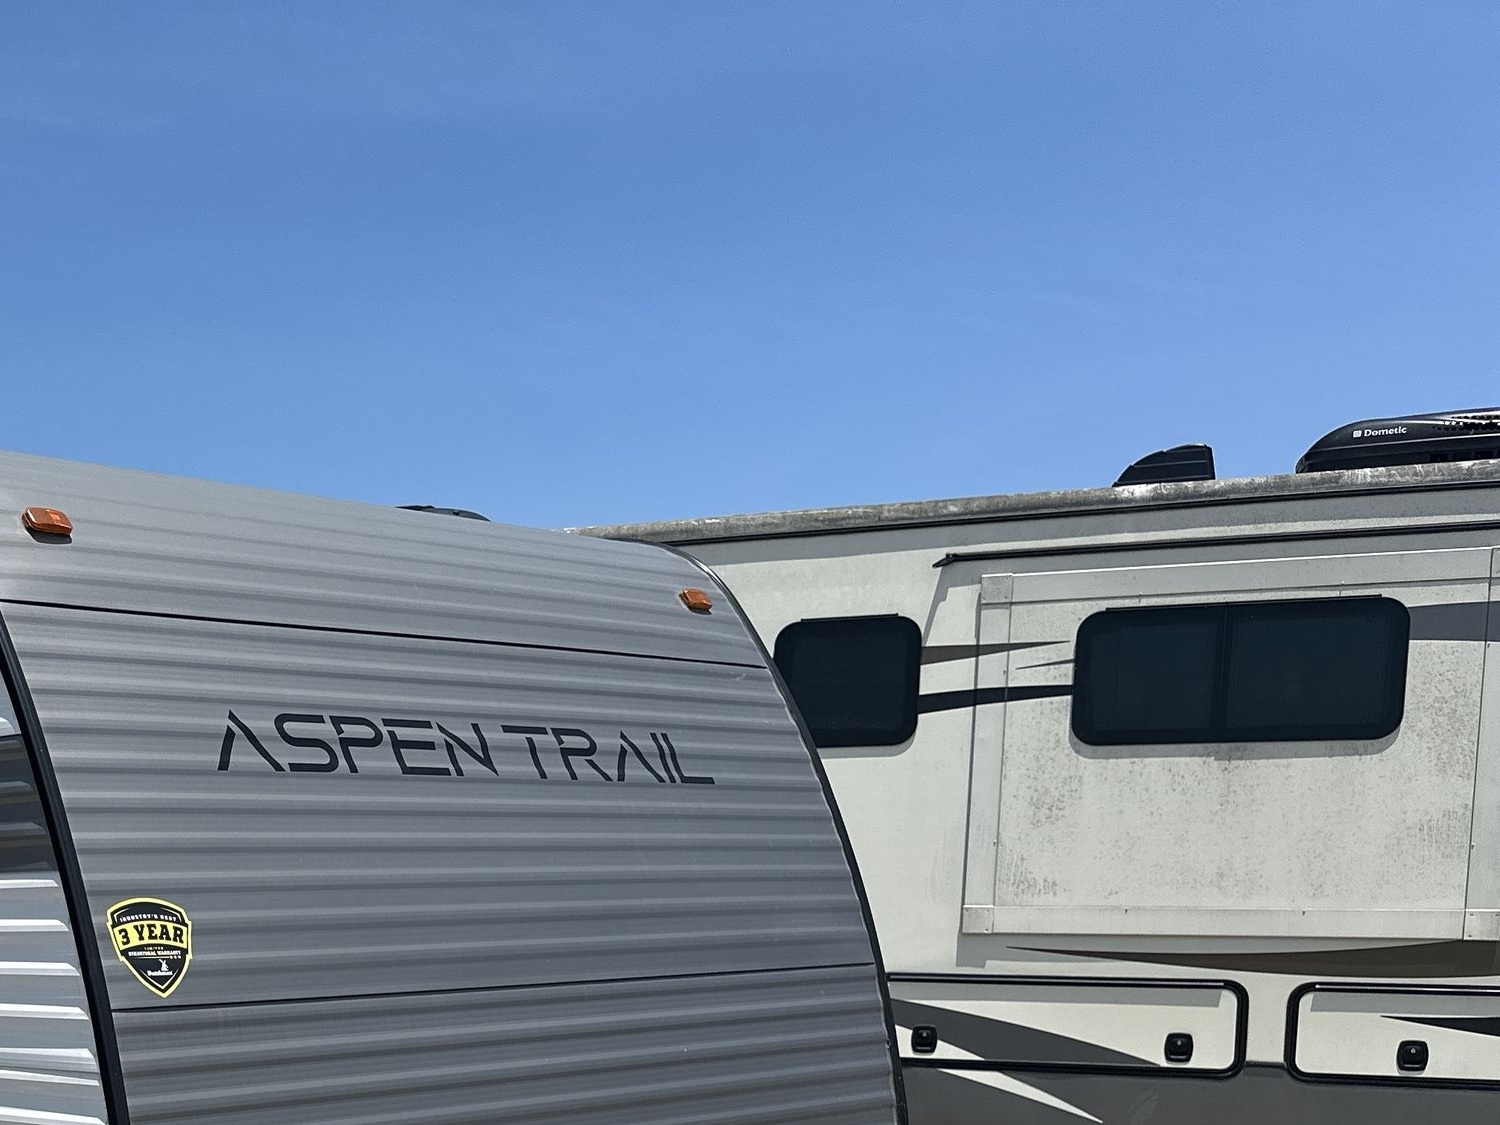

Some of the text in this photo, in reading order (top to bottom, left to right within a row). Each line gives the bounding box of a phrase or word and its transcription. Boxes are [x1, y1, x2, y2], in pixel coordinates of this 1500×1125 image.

[1363, 426, 1407, 437] Dometic
[218, 710, 715, 784] ASPEN TRAIL
[118, 924, 184, 946] 3 YEAR
